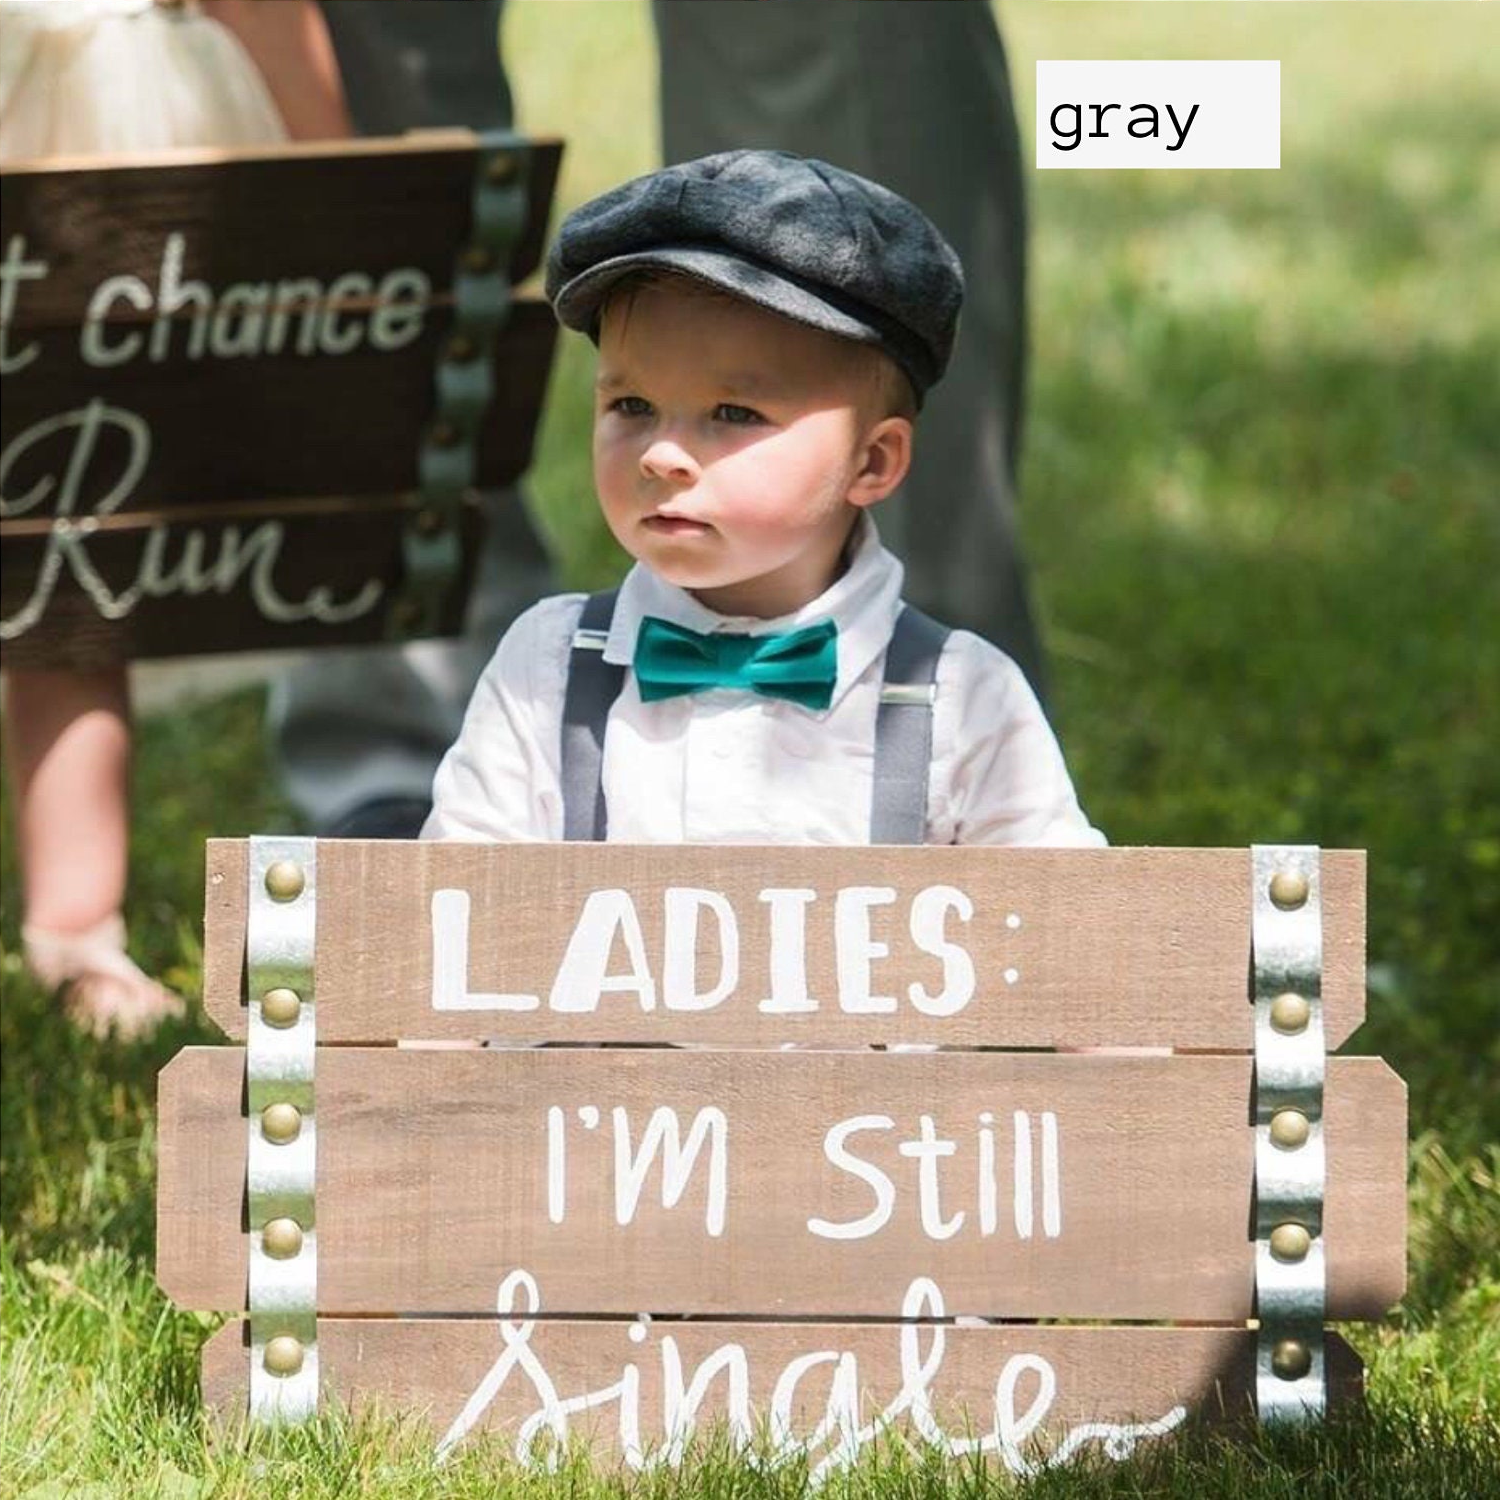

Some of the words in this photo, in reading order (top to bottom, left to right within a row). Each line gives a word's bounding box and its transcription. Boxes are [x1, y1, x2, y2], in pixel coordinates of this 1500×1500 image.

[80, 232, 431, 367] chance
[0, 397, 384, 640] Run
[430, 884, 1023, 1017] LADIES:
